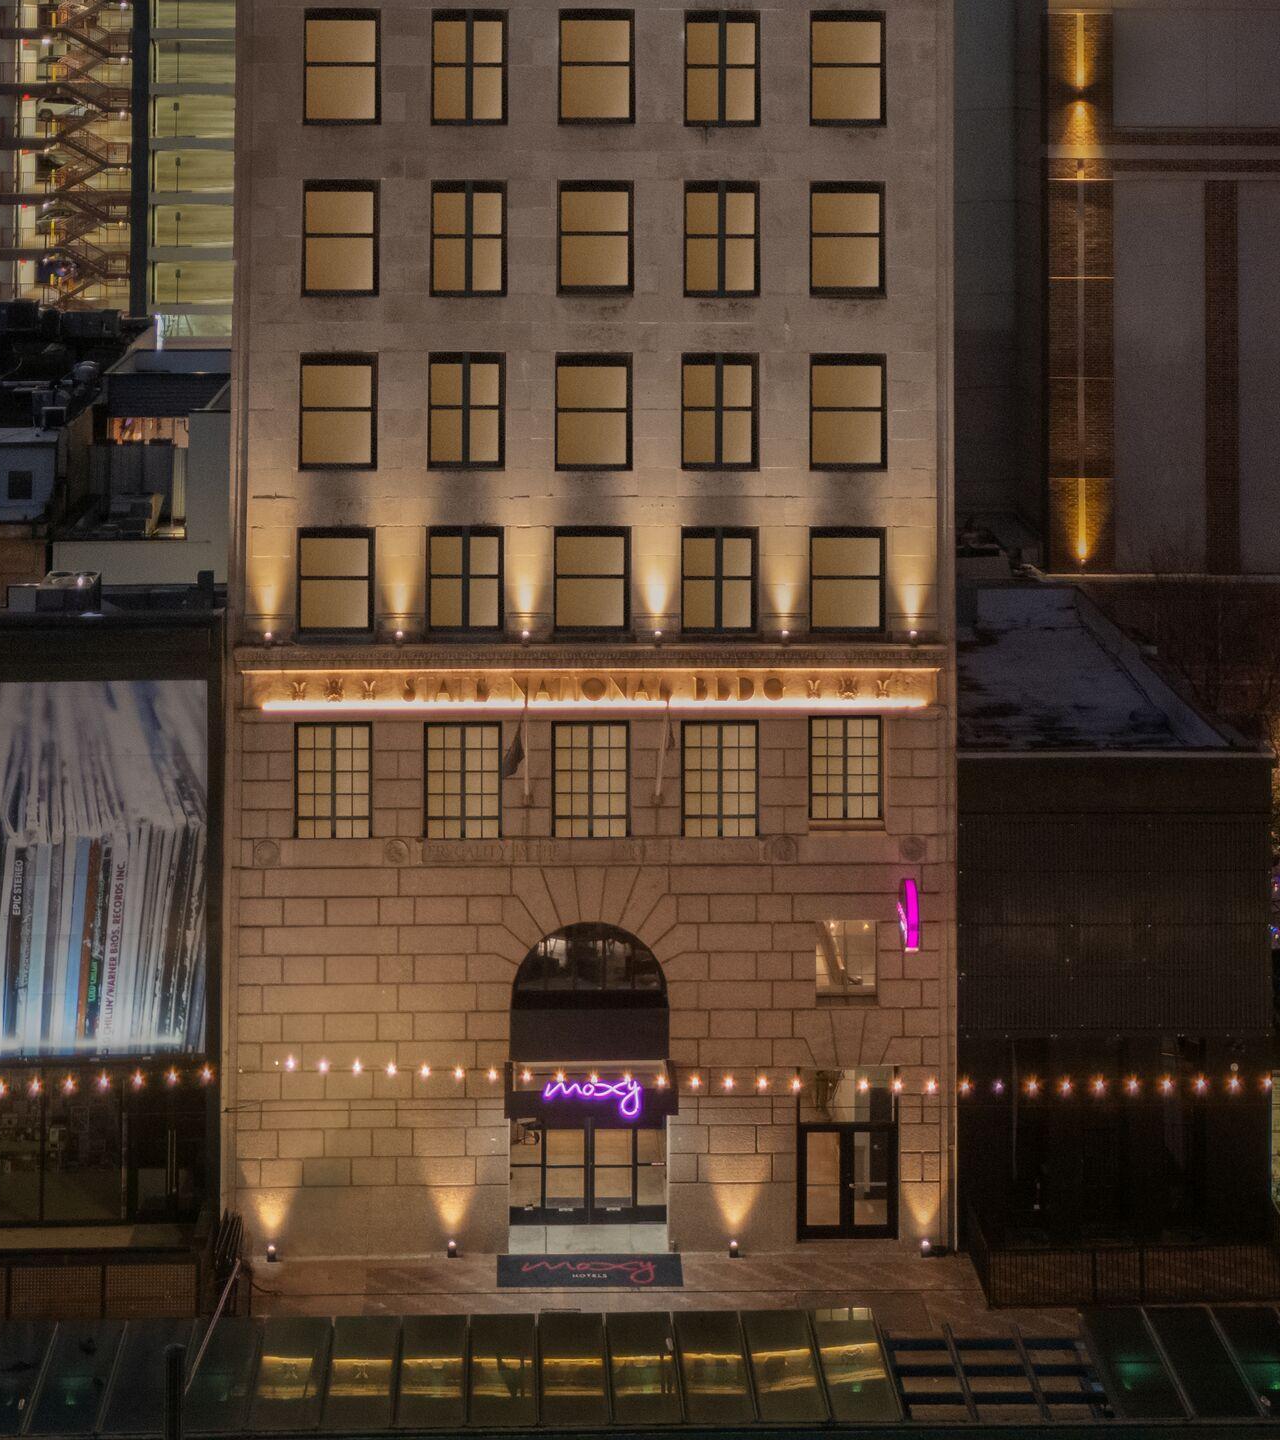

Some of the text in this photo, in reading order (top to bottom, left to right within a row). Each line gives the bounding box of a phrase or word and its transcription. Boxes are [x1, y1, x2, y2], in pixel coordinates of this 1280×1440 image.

[402, 676, 787, 702] STATE NATIONAL BLDG
[116, 861, 126, 880] INC.
[12, 859, 24, 916] EPIC STEREO
[112, 882, 124, 925] RECORDS
[544, 1080, 642, 1117] moxy
[520, 1261, 657, 1285] moxy
